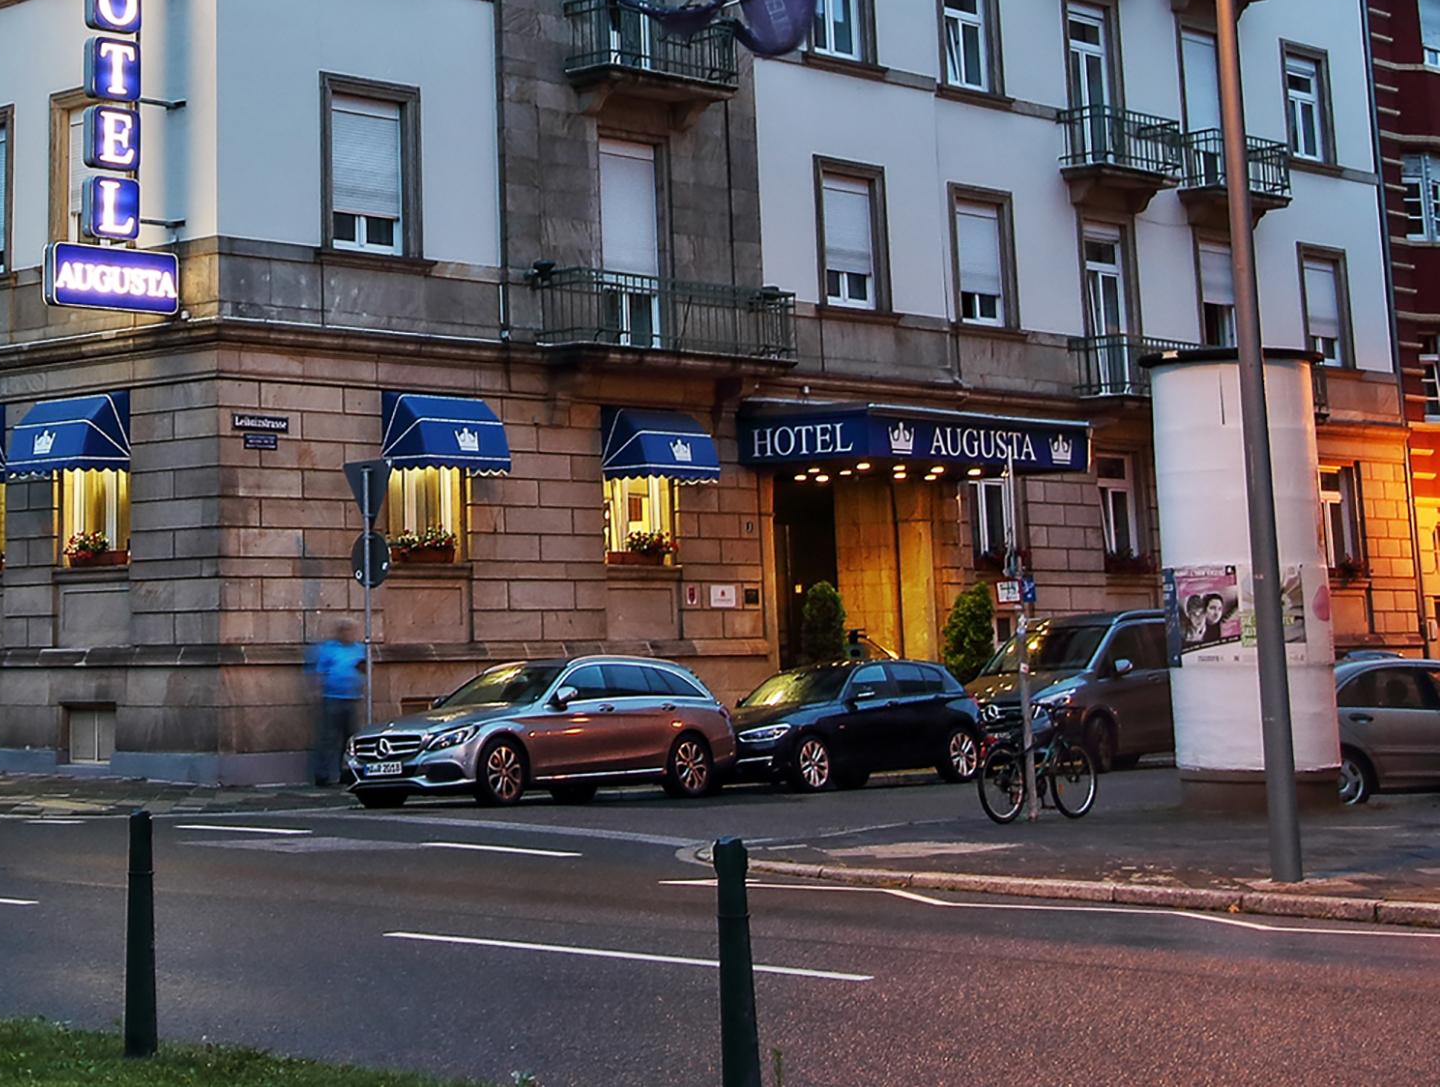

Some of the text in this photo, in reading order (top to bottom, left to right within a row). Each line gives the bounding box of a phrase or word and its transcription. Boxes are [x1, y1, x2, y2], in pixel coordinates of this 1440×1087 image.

[56, 262, 177, 298] AUGUSTA
[752, 422, 1037, 461] HOTEL AUGUSTA
